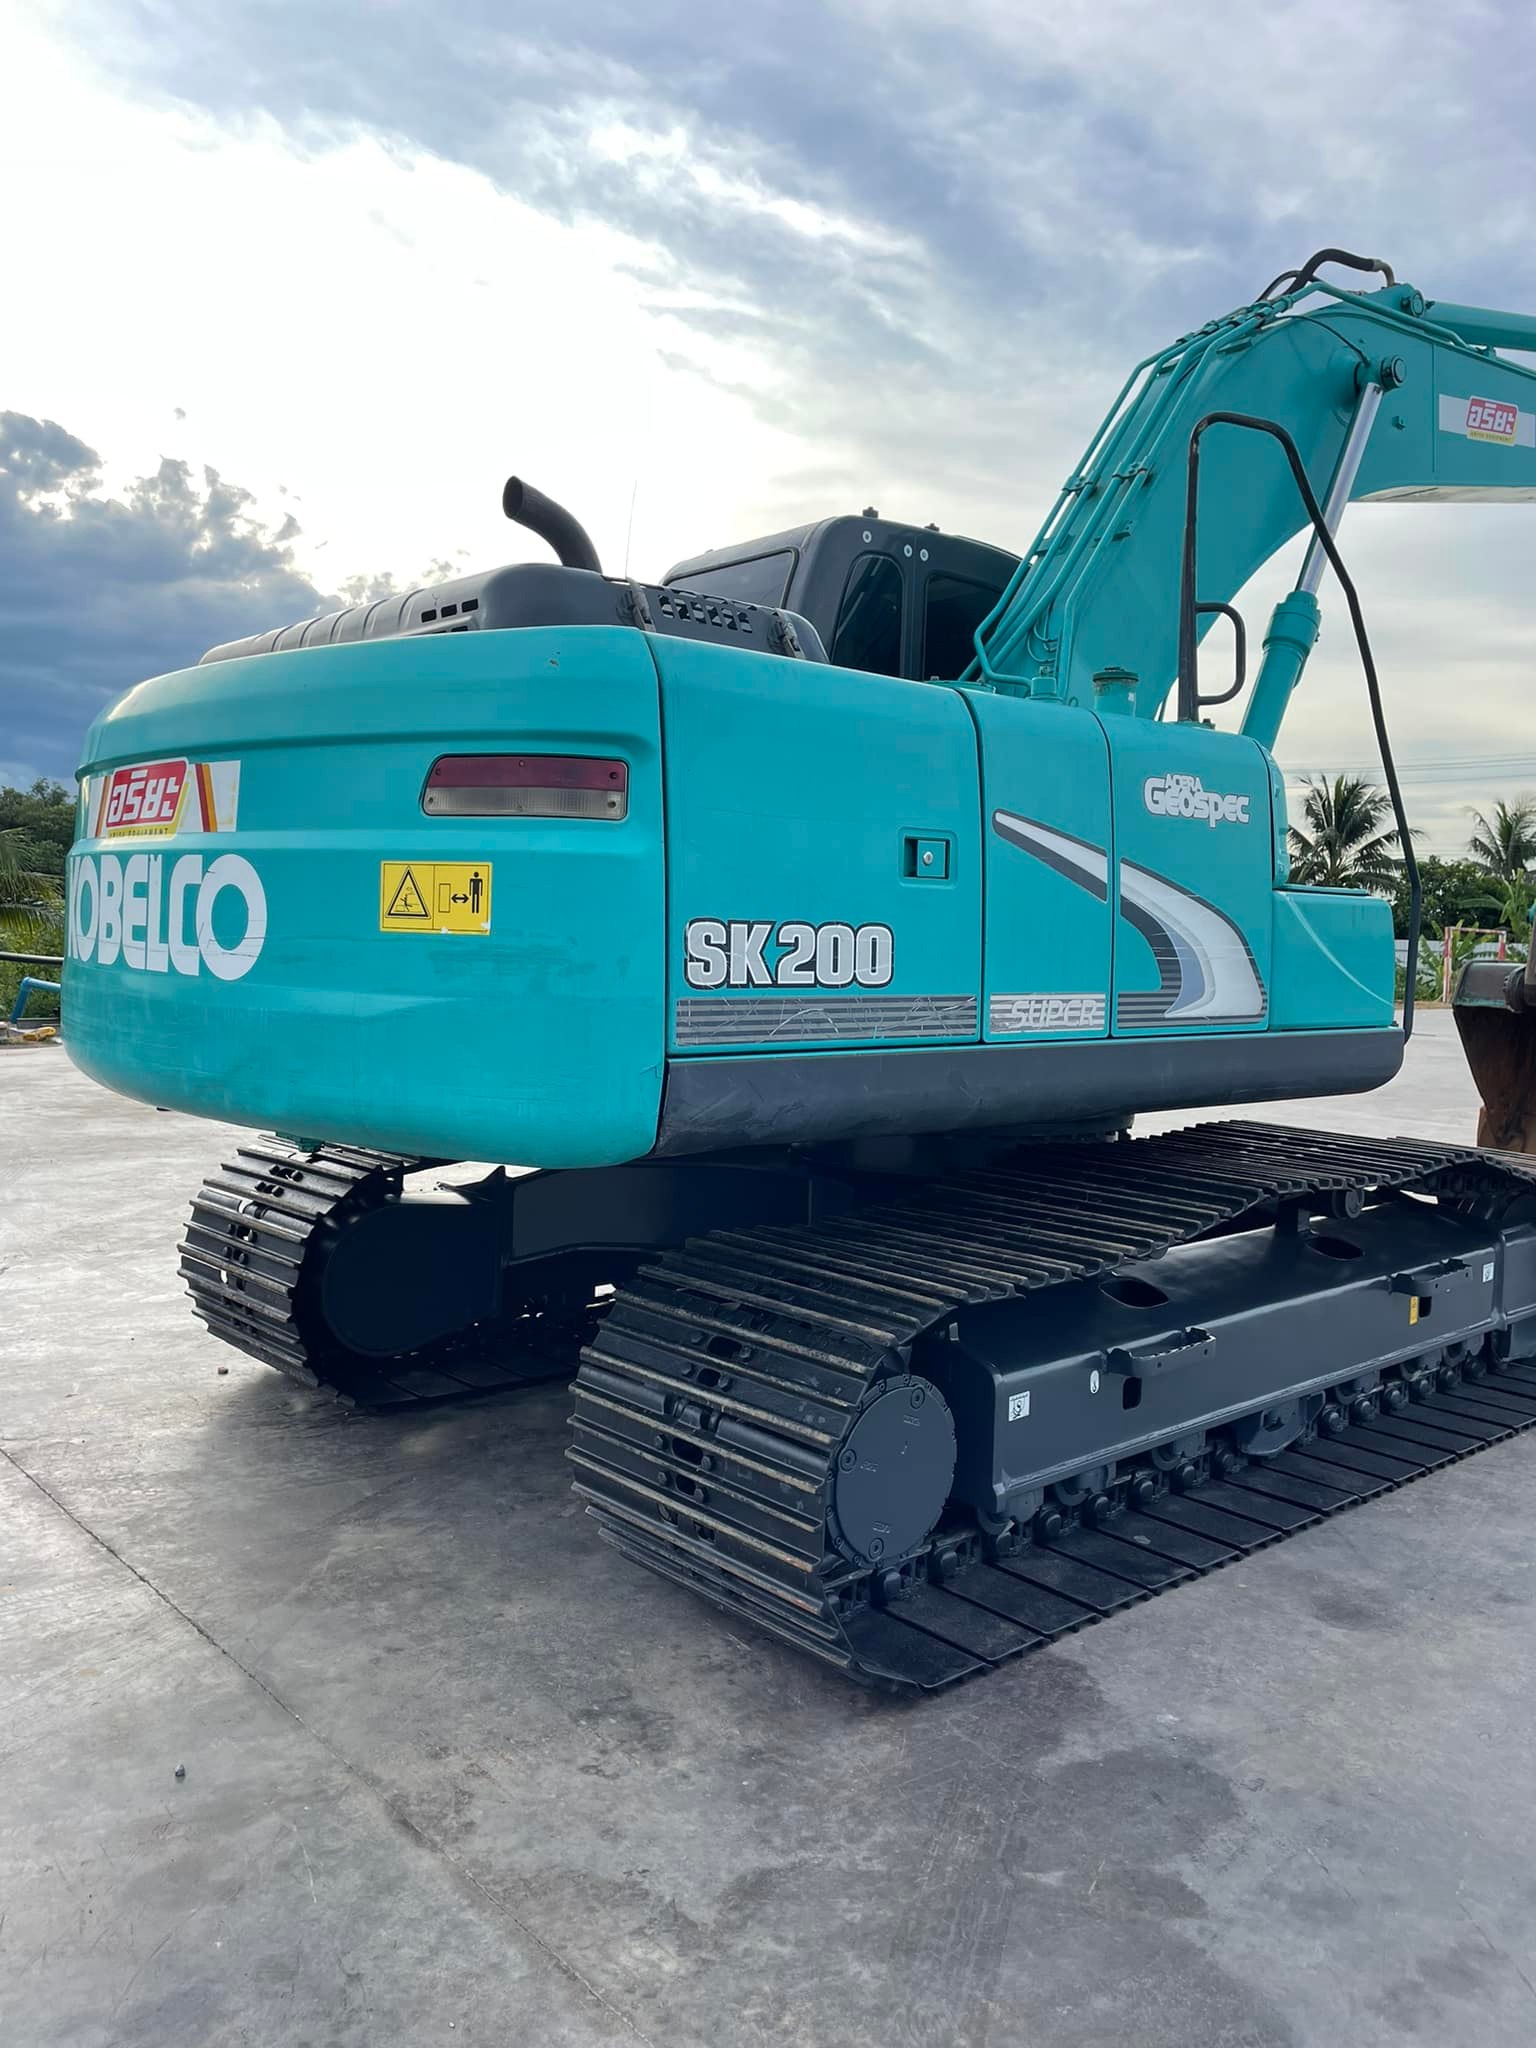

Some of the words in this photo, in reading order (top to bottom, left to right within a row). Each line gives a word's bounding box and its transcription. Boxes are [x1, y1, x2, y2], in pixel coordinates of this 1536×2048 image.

[1144, 777, 1249, 828] Geospec
[685, 918, 893, 988] SK200
[1008, 999, 1097, 1028] SUPER
